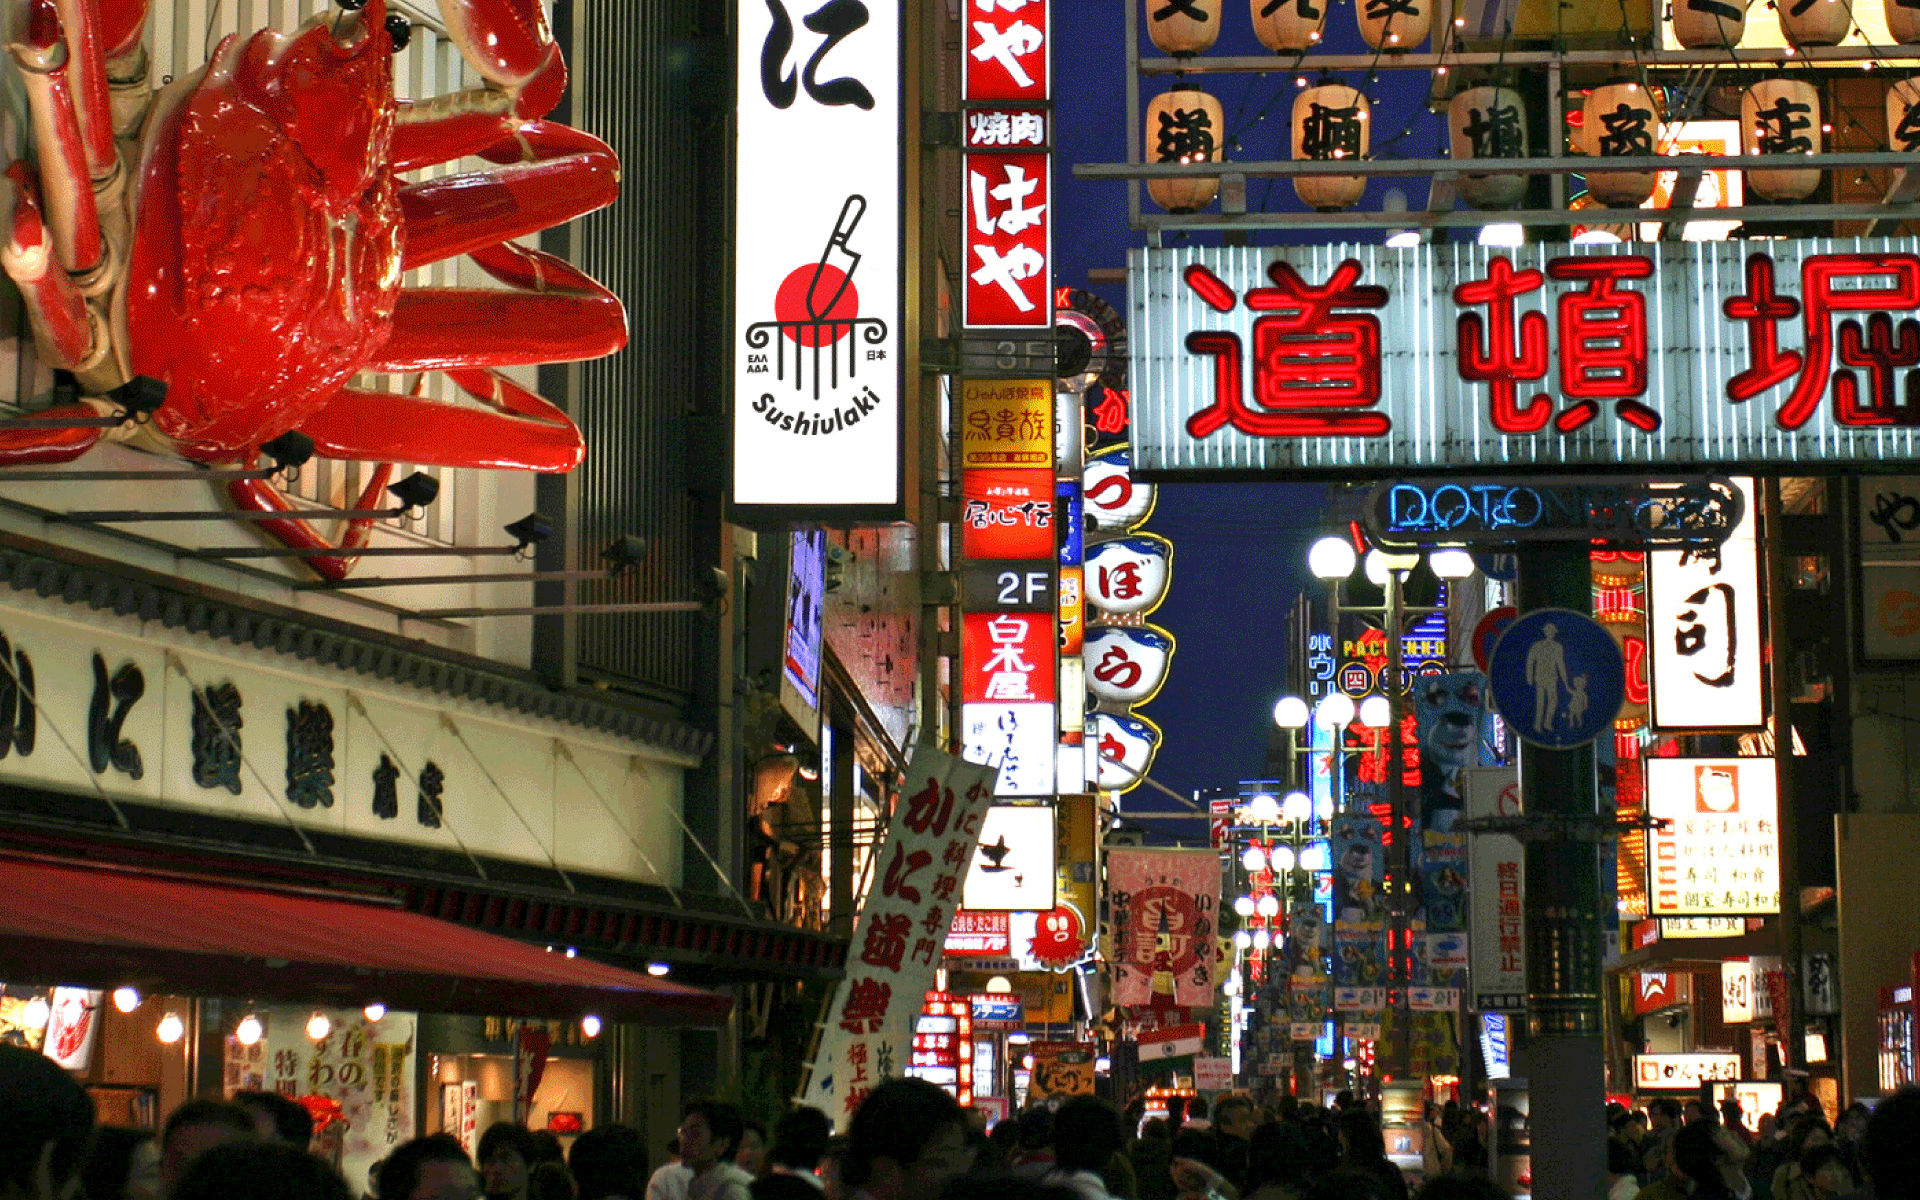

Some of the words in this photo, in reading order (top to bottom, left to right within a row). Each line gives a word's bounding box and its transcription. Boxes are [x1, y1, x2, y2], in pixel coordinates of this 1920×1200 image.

[969, 0, 1045, 89] や
[969, 111, 1044, 145] 焼肉
[970, 163, 1047, 313] はや
[866, 349, 887, 361] 日本
[996, 340, 1049, 370] 3F
[1185, 255, 1920, 437] 道頓堀
[996, 571, 1049, 605] 2F
[981, 614, 1035, 701] 白木屋
